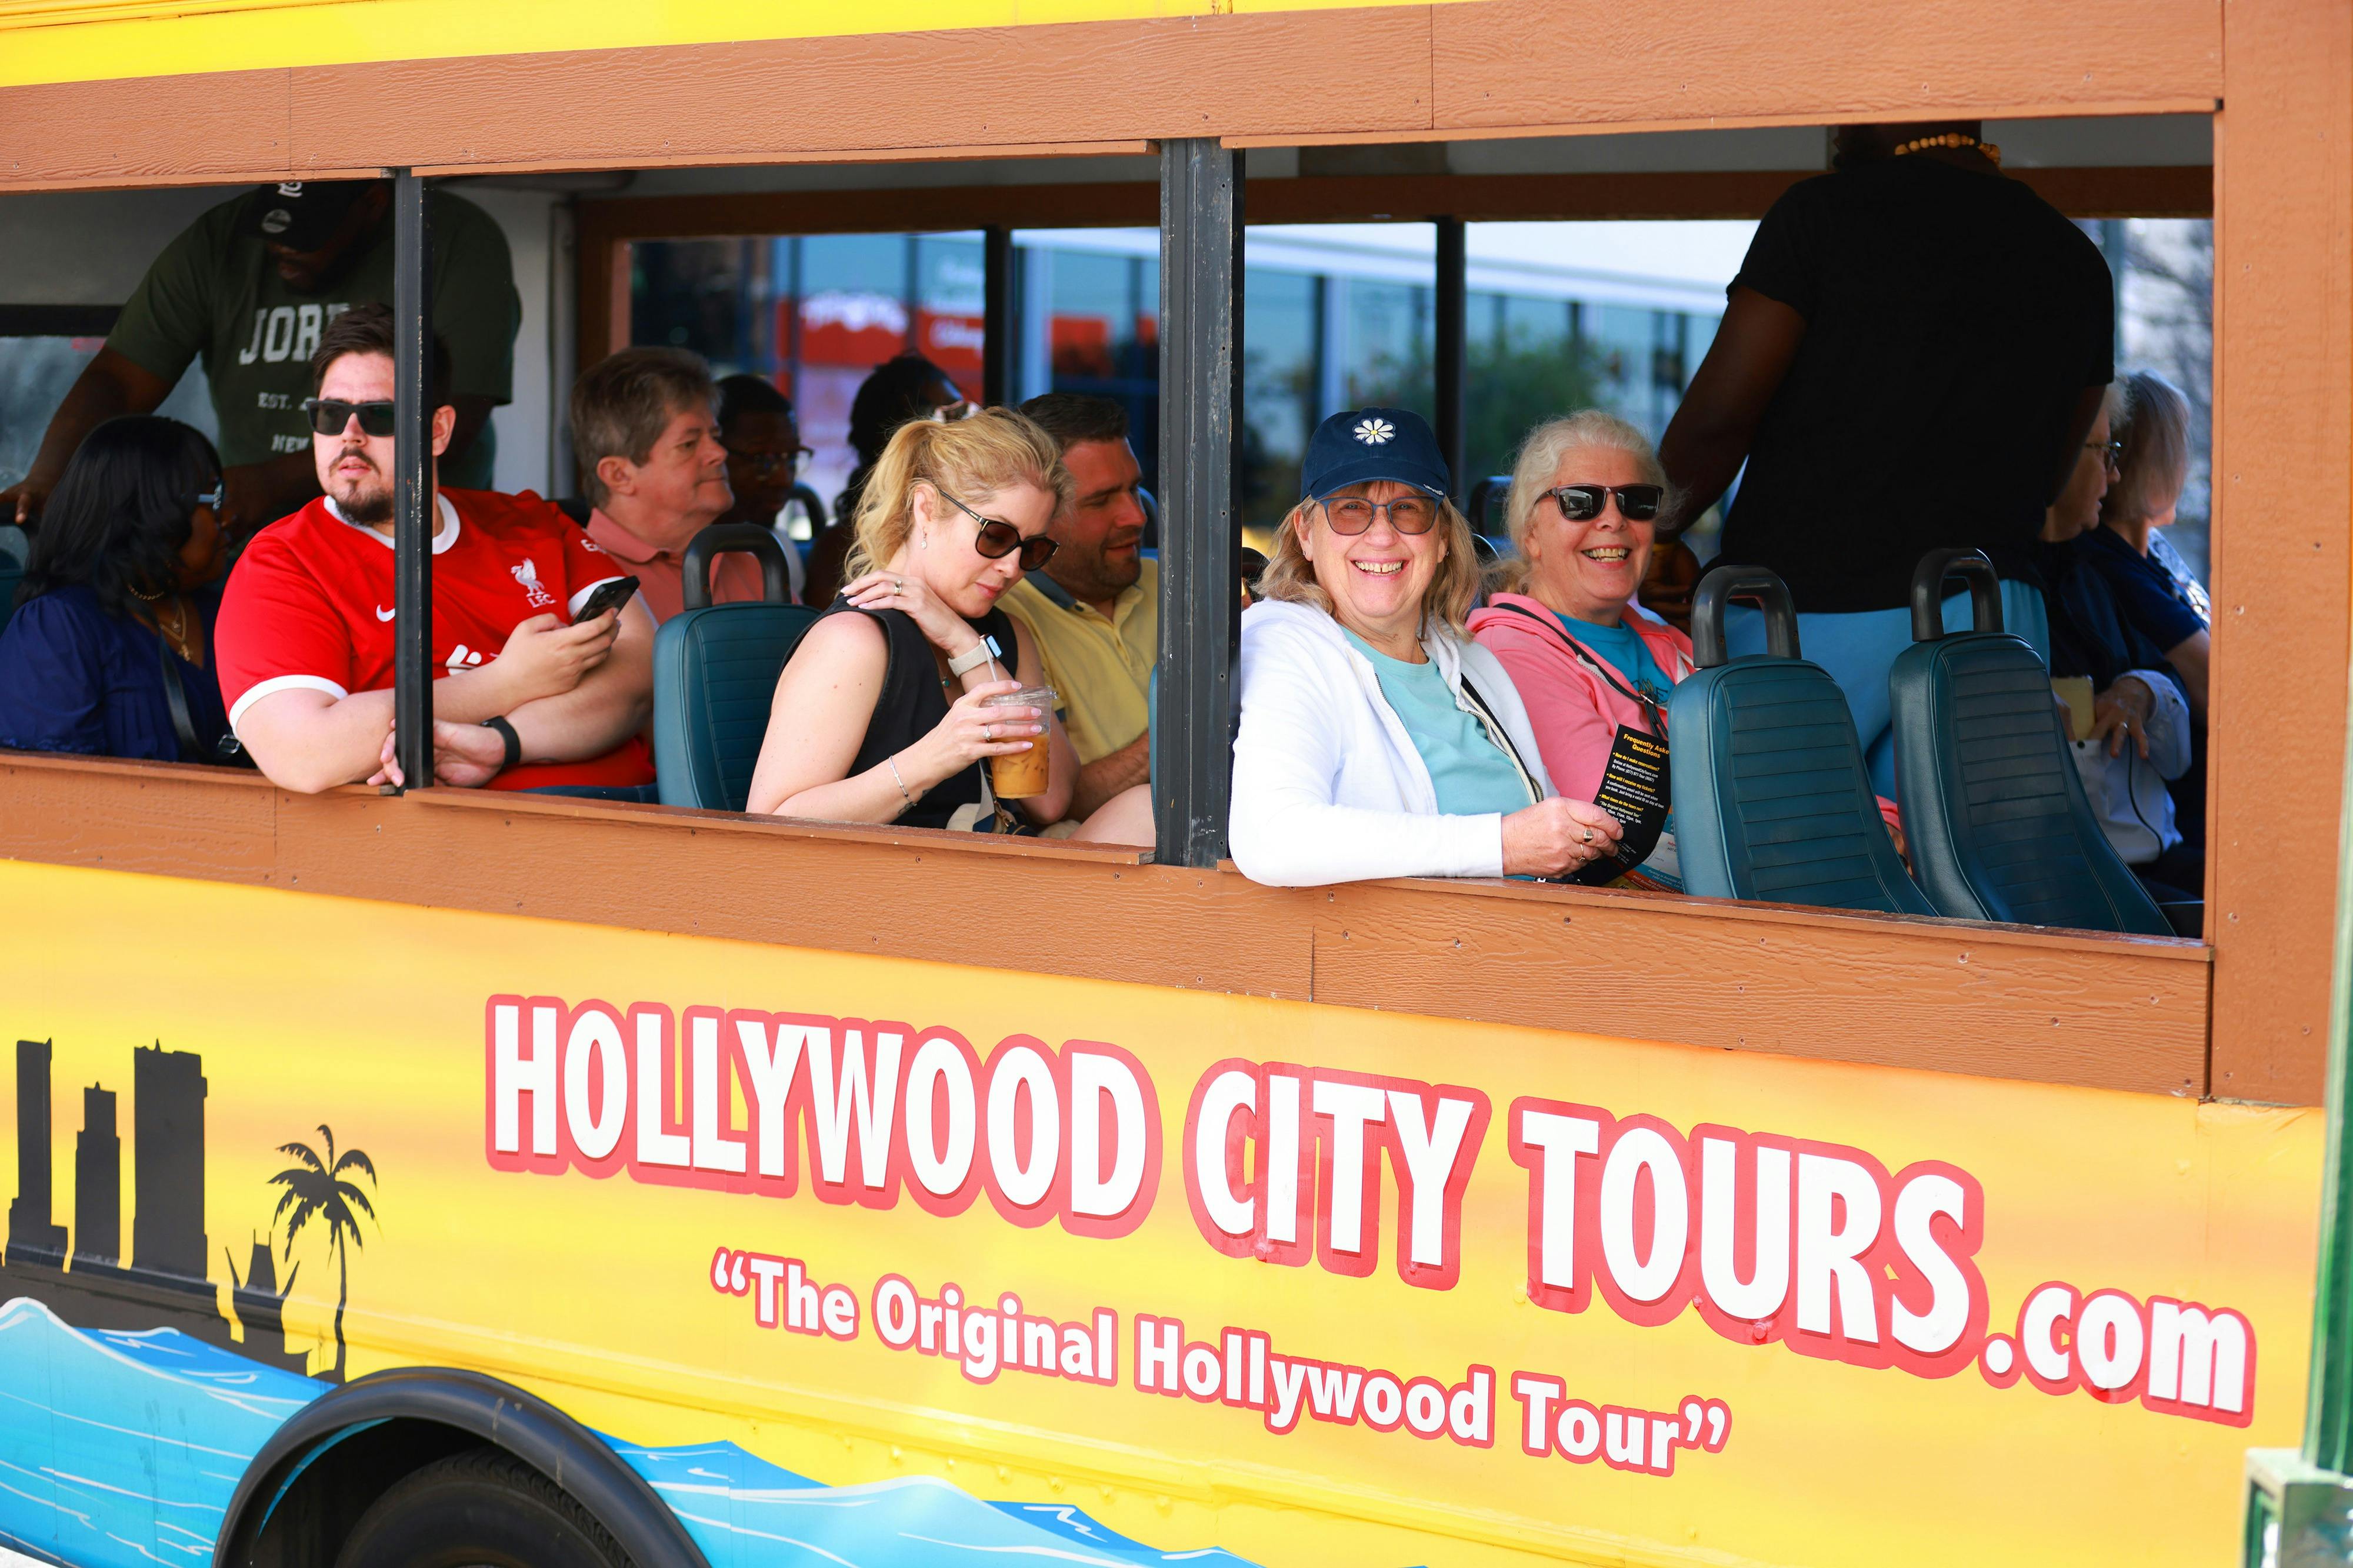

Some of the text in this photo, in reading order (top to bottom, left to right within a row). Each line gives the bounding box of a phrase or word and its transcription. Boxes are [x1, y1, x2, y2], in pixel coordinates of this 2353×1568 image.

[1632, 743, 1661, 758] Questions
[1654, 745, 1669, 755] Aske
[493, 1003, 1147, 1217] HOLLYWOOD
[1195, 1069, 1476, 1269] CITY
[875, 1279, 1113, 1380] Original
[1139, 1320, 1494, 1442] Hollywood
